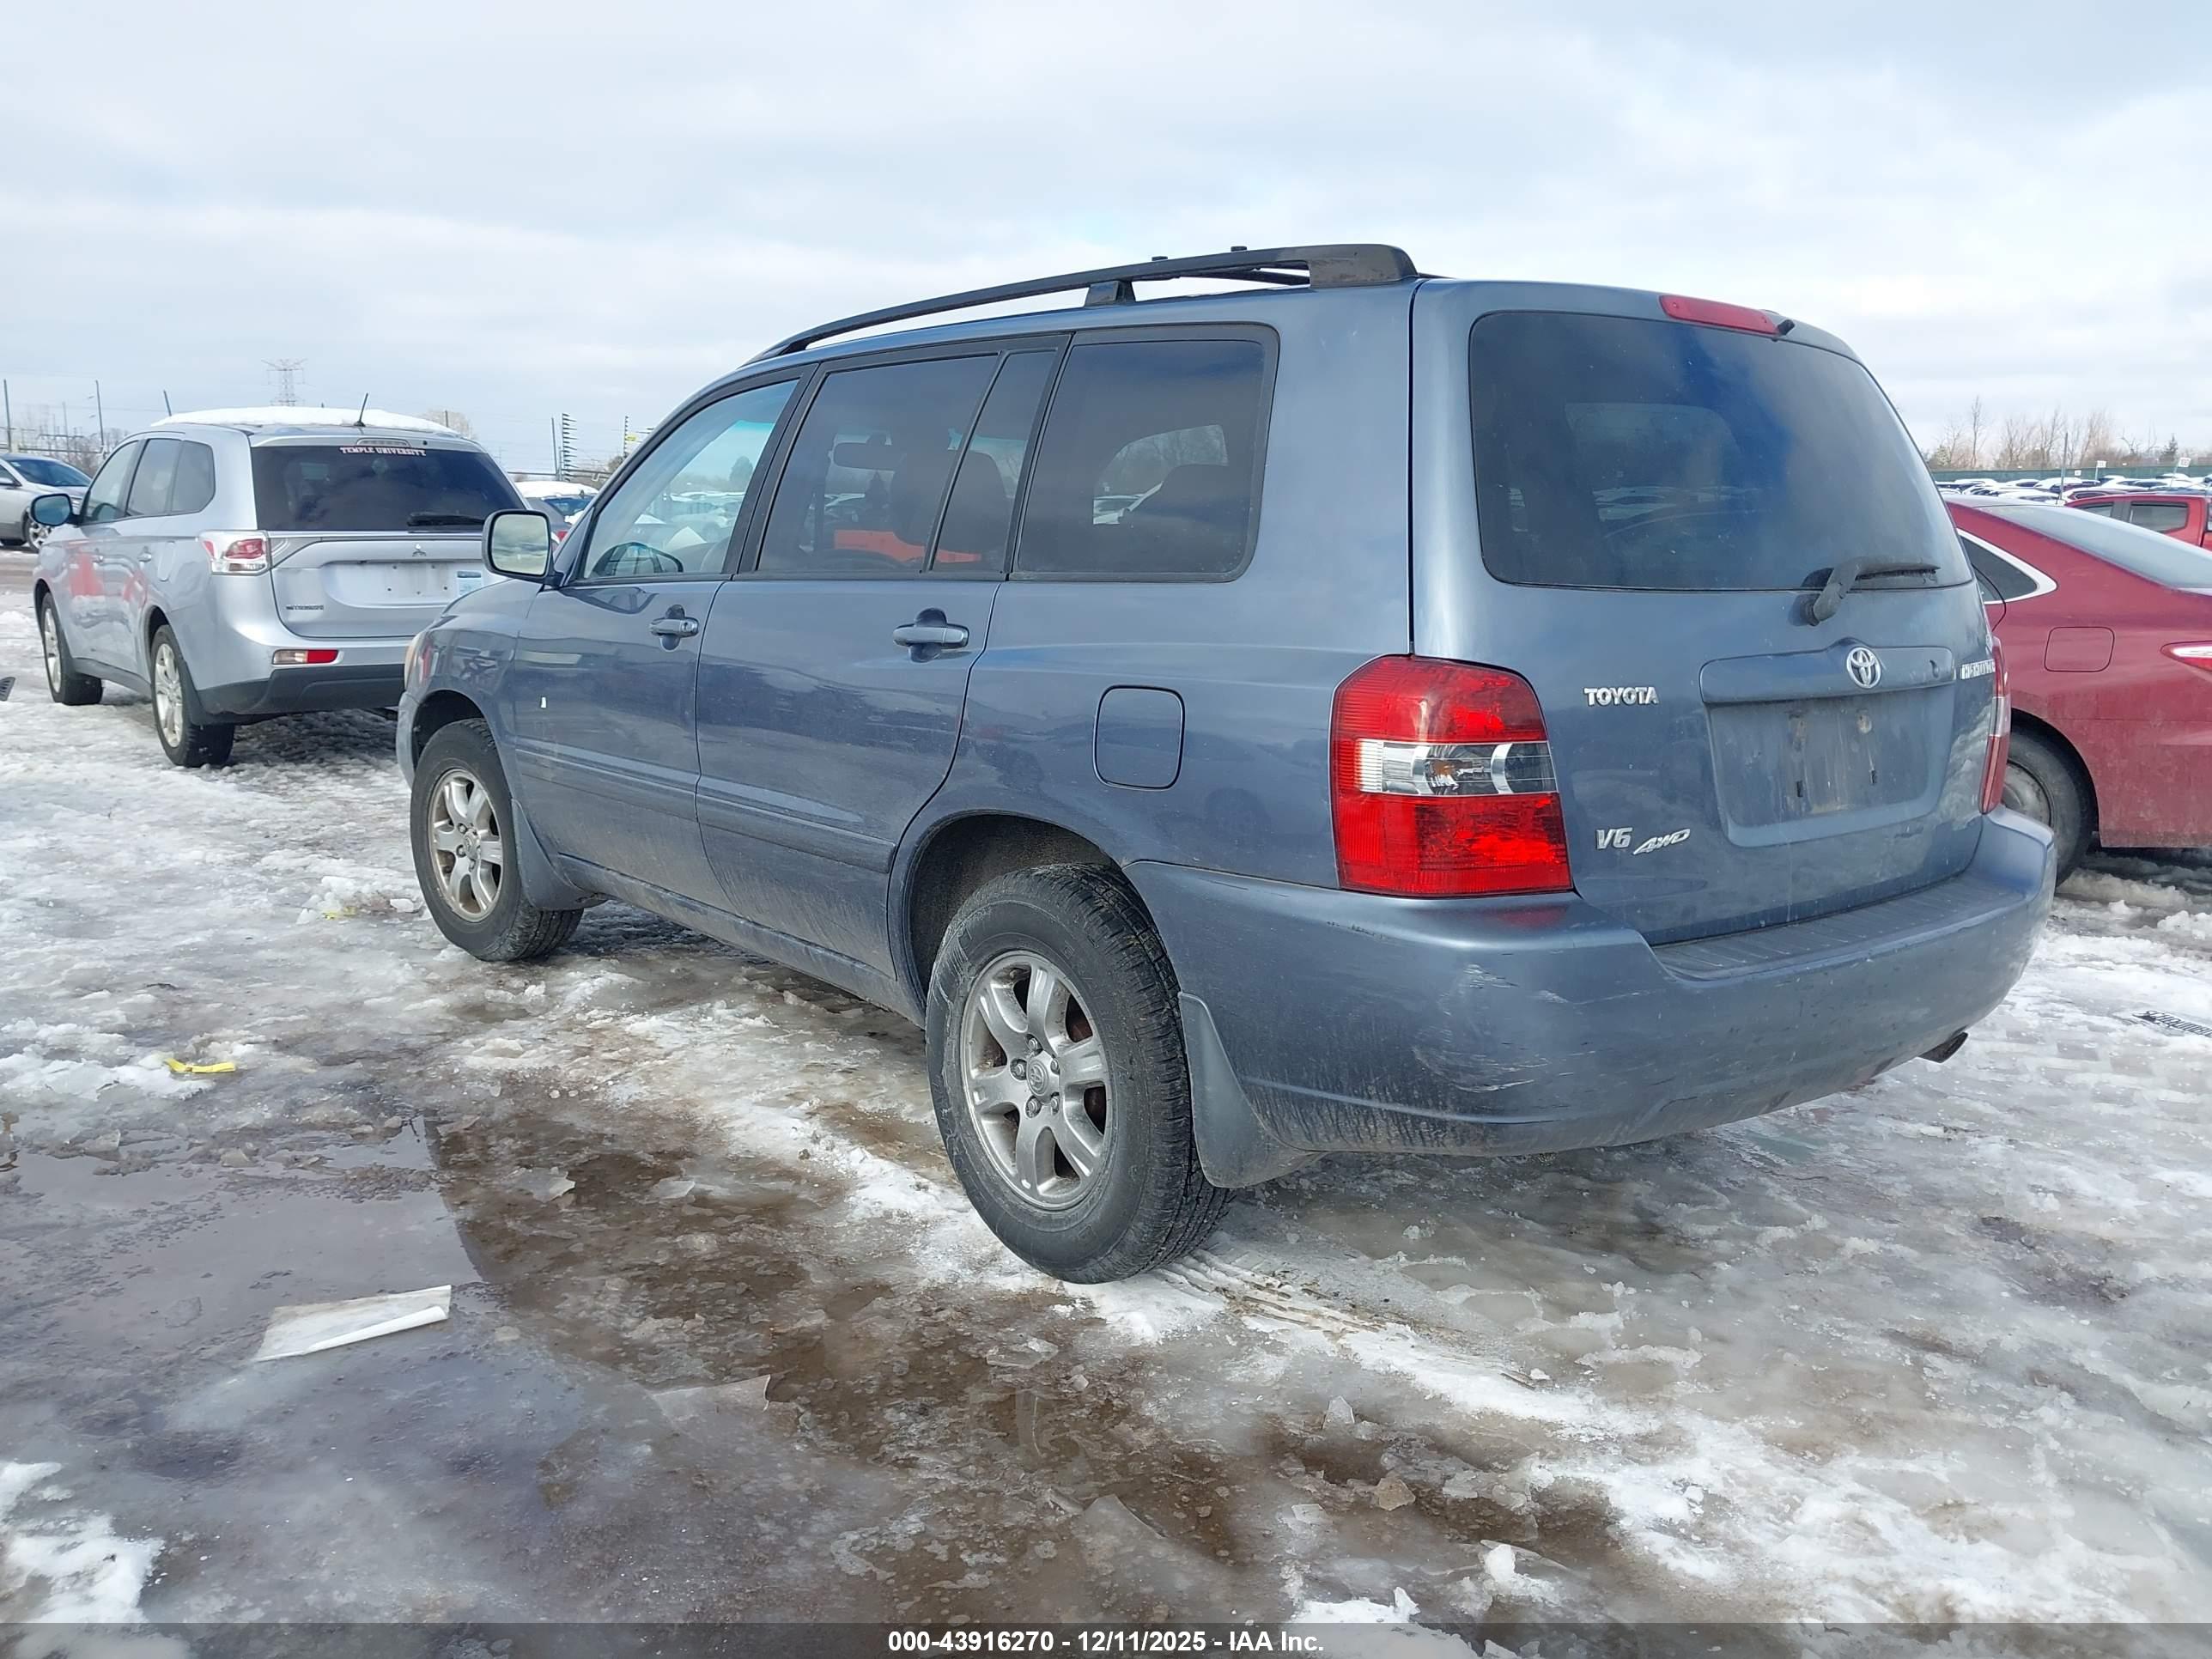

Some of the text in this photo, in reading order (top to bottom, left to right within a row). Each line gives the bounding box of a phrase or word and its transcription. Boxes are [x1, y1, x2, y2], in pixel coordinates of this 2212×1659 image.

[375, 447, 426, 456] UNIVERSITY
[1583, 686, 1659, 707] TOYOTA
[1596, 827, 1632, 850] V6
